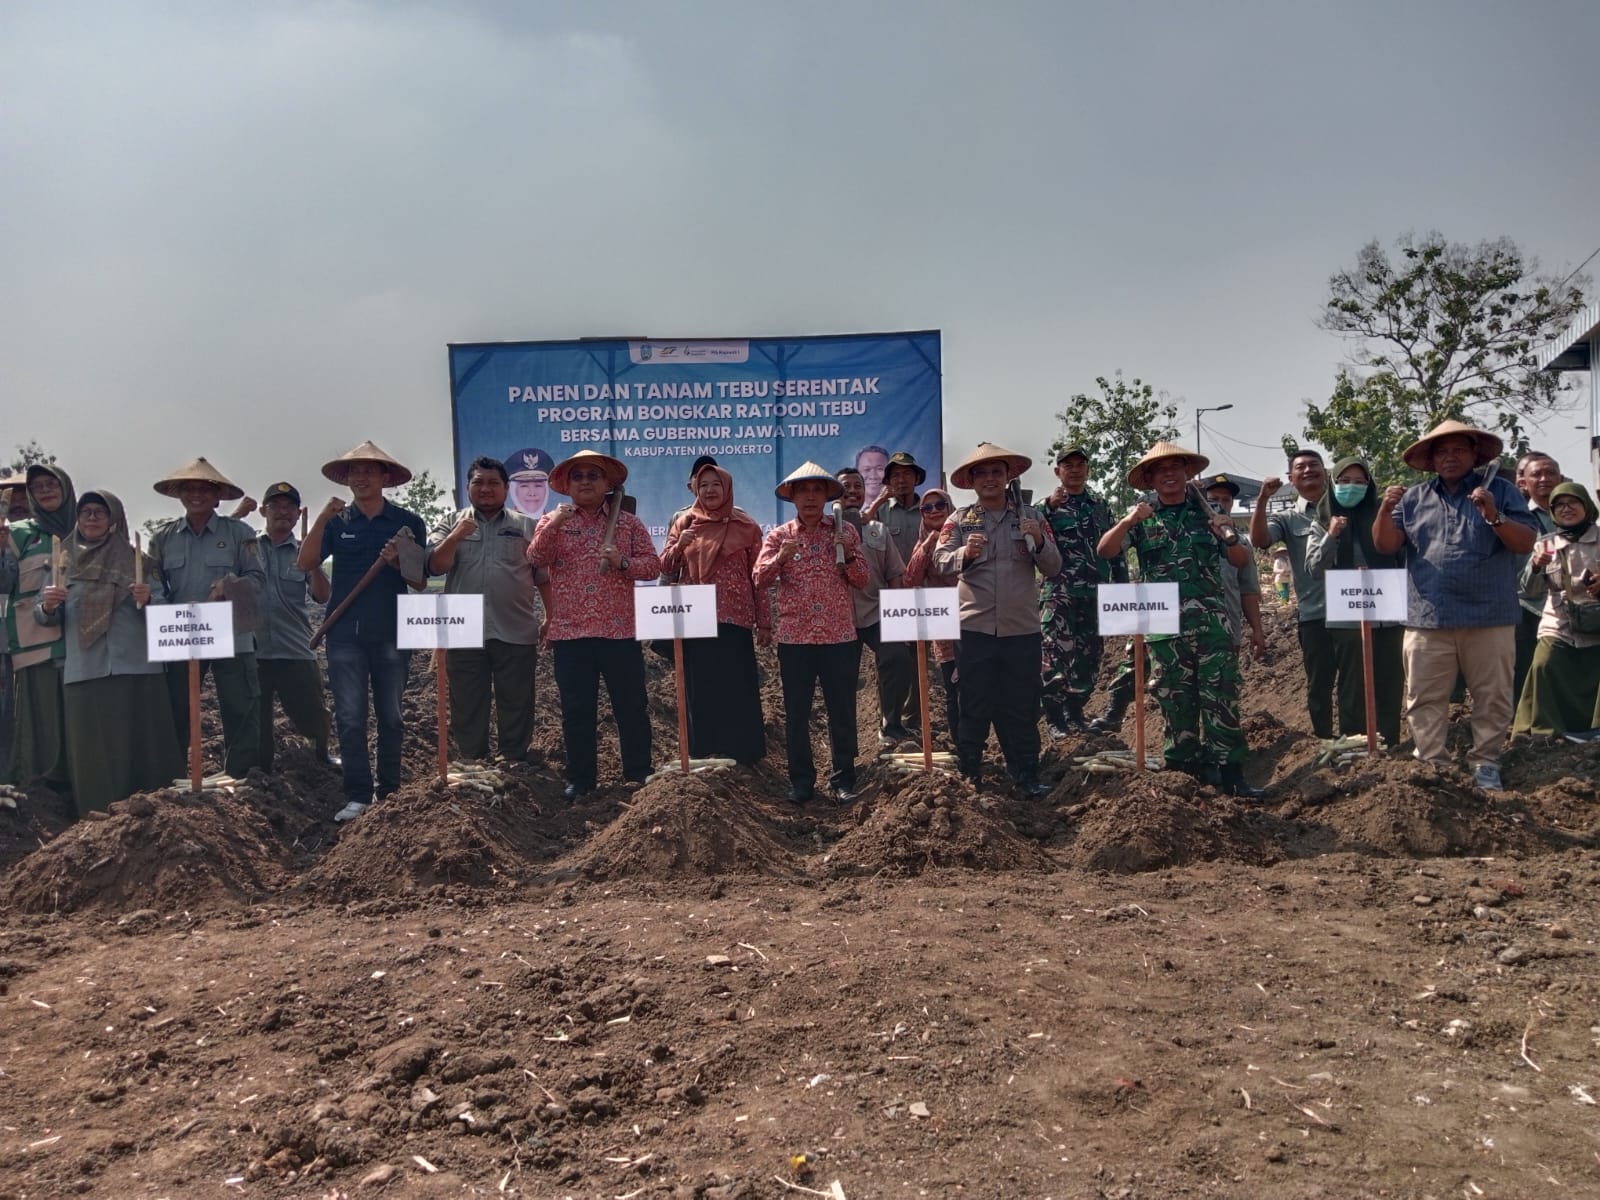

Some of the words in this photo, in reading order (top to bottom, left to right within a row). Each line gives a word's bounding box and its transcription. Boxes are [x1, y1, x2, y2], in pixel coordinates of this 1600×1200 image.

[509, 384, 580, 402] PANEN
[584, 383, 630, 400] DAN
[634, 381, 712, 399] TANAM
[717, 380, 768, 398] TEBU
[772, 377, 880, 396] SERENTAK
[538, 405, 634, 422] PROGRAM
[638, 403, 732, 420] BONGKAR
[736, 401, 816, 418] RATOON
[820, 400, 866, 416] TEBU
[560, 427, 640, 442] BERSAMA
[643, 426, 731, 440] GUBERNUR
[735, 425, 785, 439] JAWA
[788, 423, 840, 437] TIMUR
[624, 446, 696, 457] KABUPATEN
[698, 444, 773, 456] MOJOKERTO
[1341, 588, 1383, 596] KEPALA
[651, 604, 693, 614] CAMAT
[883, 607, 949, 618] KAPOLSEK
[1103, 602, 1168, 612] DANRAMIL
[175, 610, 196, 618] Plh.
[407, 617, 464, 625] KADISTAN
[160, 622, 212, 633] GENERAL
[158, 636, 215, 647] MANAGER
